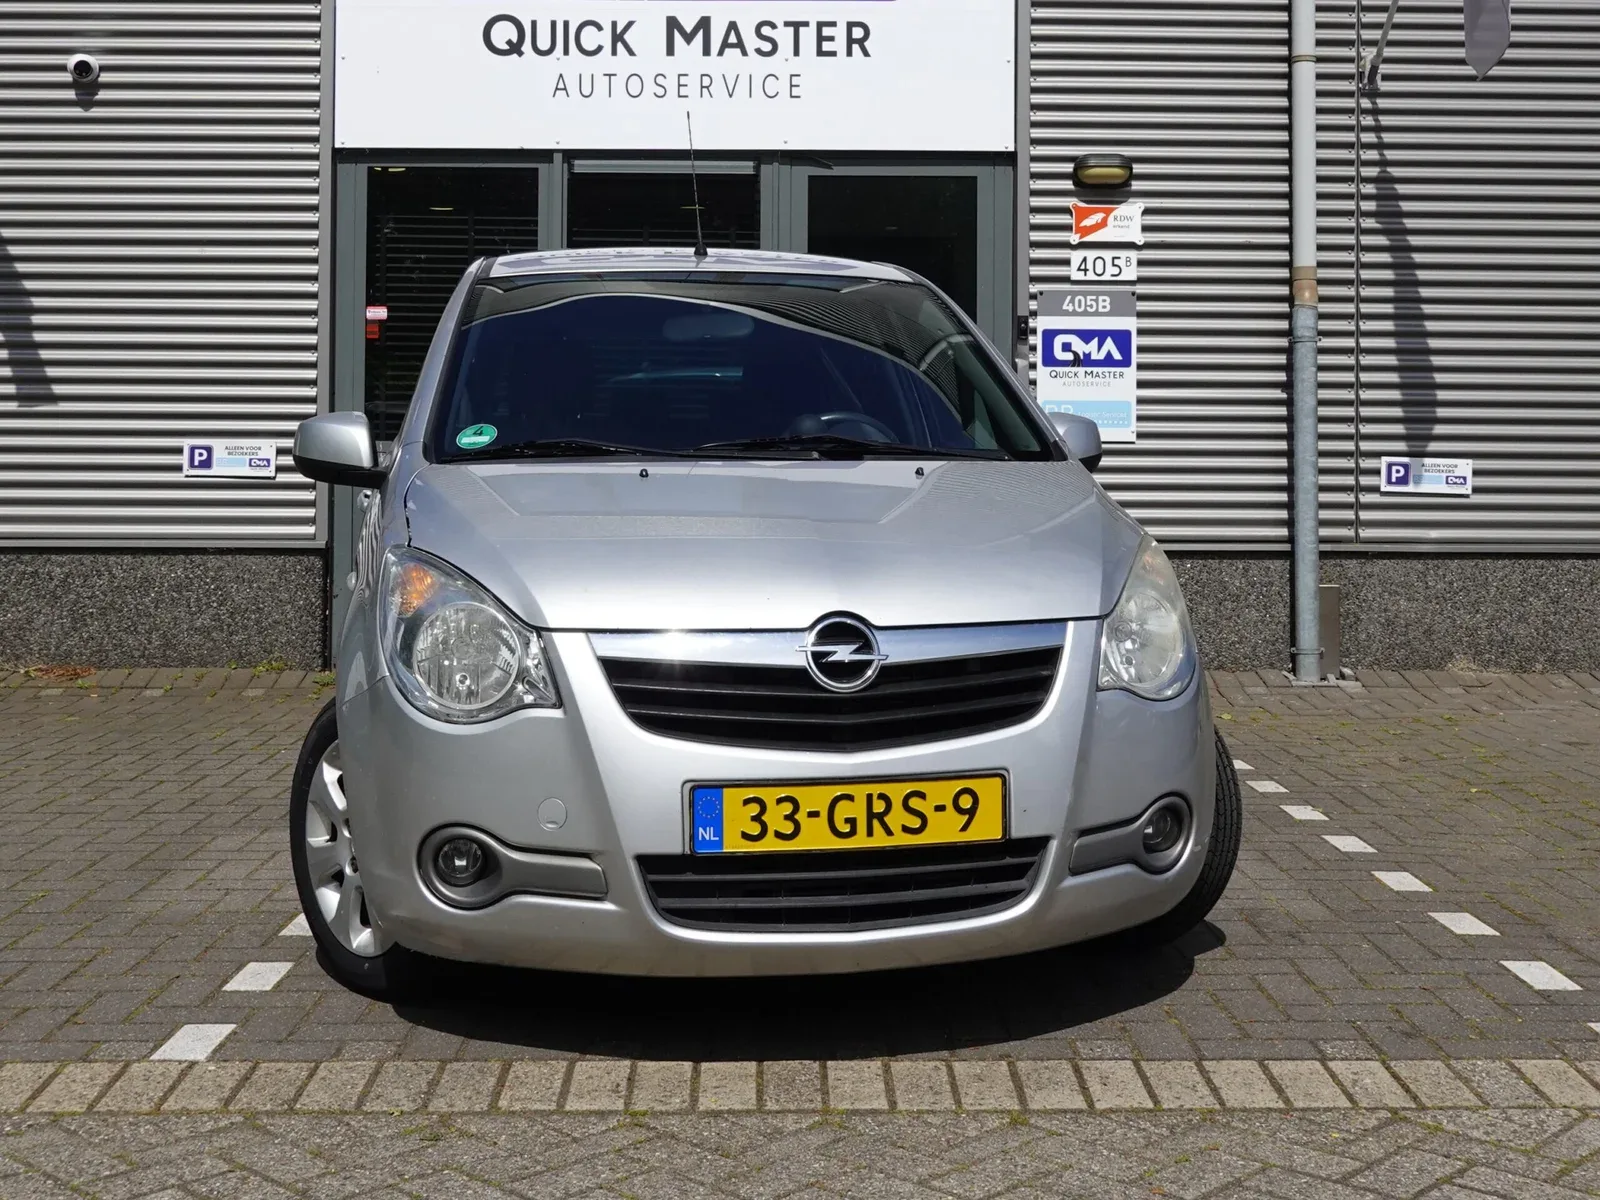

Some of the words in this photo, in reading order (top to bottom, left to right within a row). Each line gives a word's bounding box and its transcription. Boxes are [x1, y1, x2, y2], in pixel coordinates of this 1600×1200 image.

[482, 14, 637, 58] QUICK
[665, 15, 872, 57] MASTER
[552, 73, 802, 99] AUTOSERVICE
[1062, 295, 1111, 312] 405B
[1049, 370, 1080, 379] QUICK
[1084, 370, 1125, 379] MASTER
[473, 425, 484, 436] 4
[193, 448, 208, 466] P
[1391, 465, 1405, 482] P
[740, 786, 980, 842] 33-GRS-9
[698, 827, 719, 841] NL
